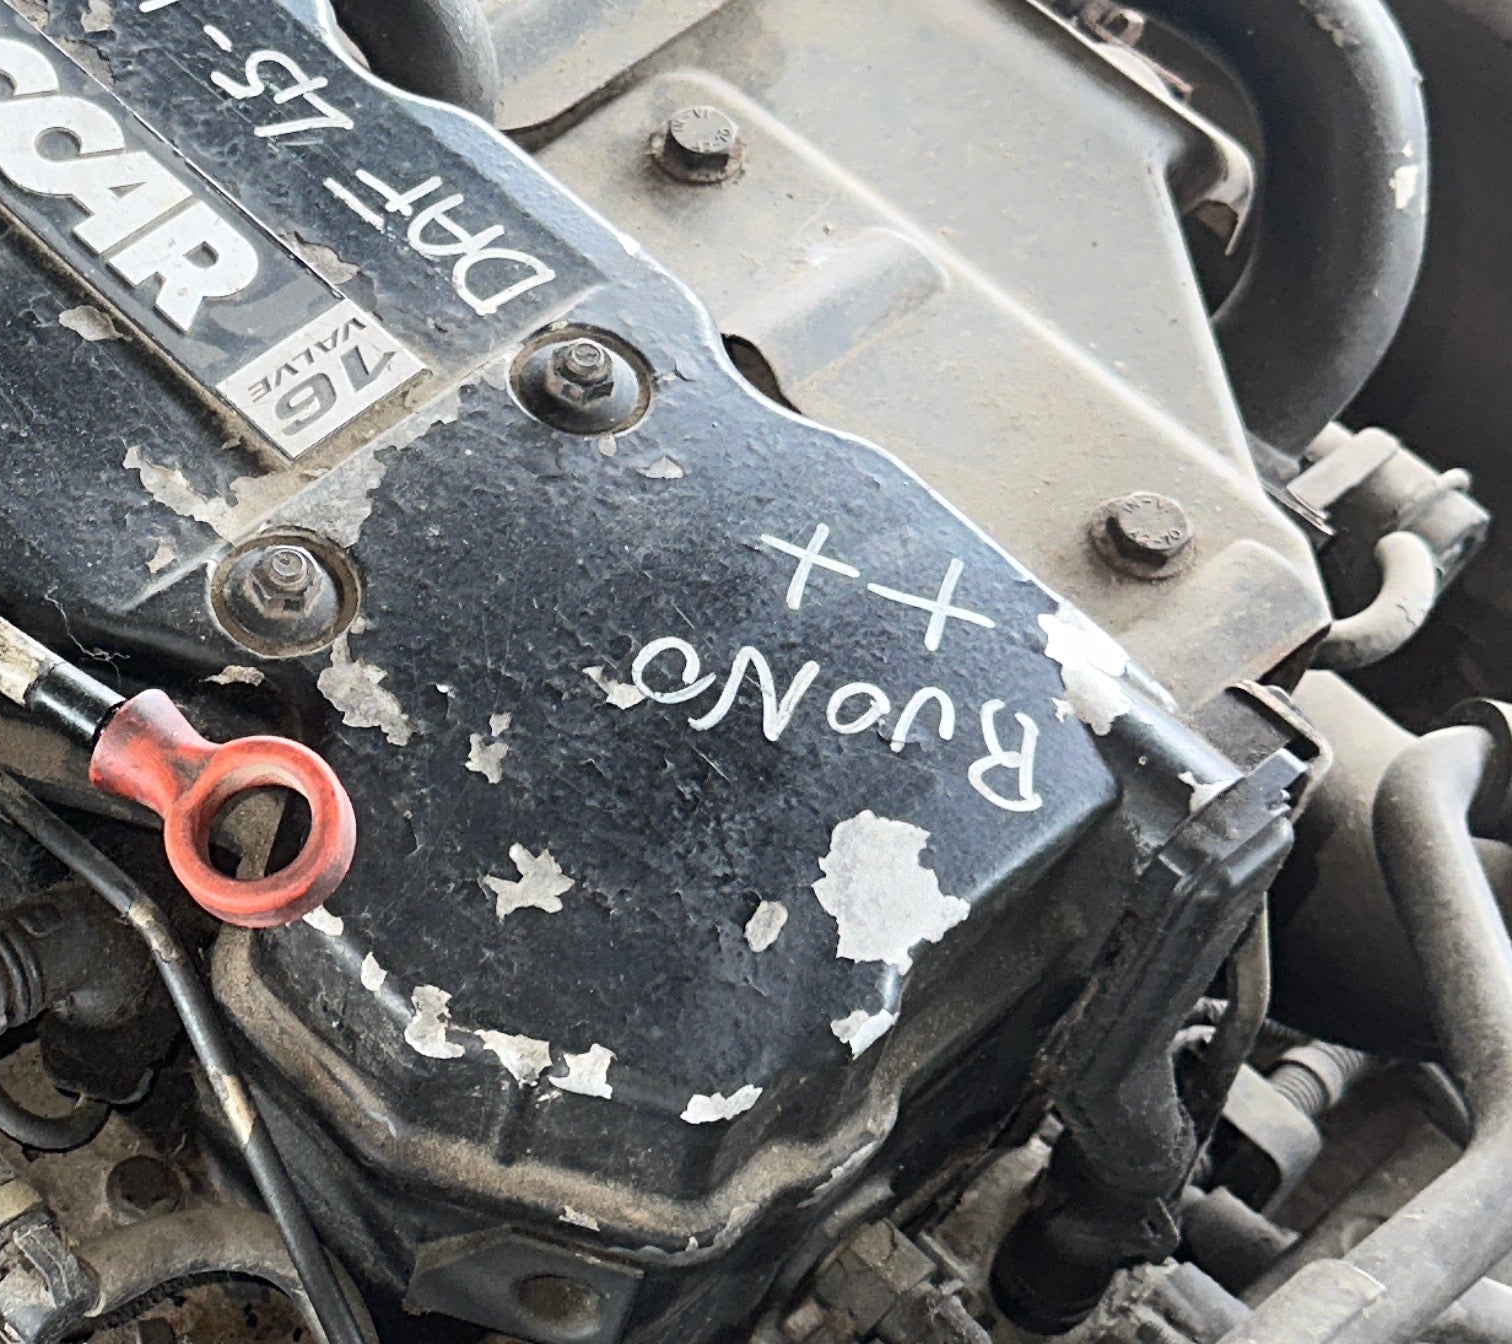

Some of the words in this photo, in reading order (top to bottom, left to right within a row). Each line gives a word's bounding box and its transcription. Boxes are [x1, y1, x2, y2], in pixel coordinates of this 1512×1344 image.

[323, 168, 555, 315] DAF
[247, 317, 367, 403] VALVE
[274, 345, 397, 436] 16
